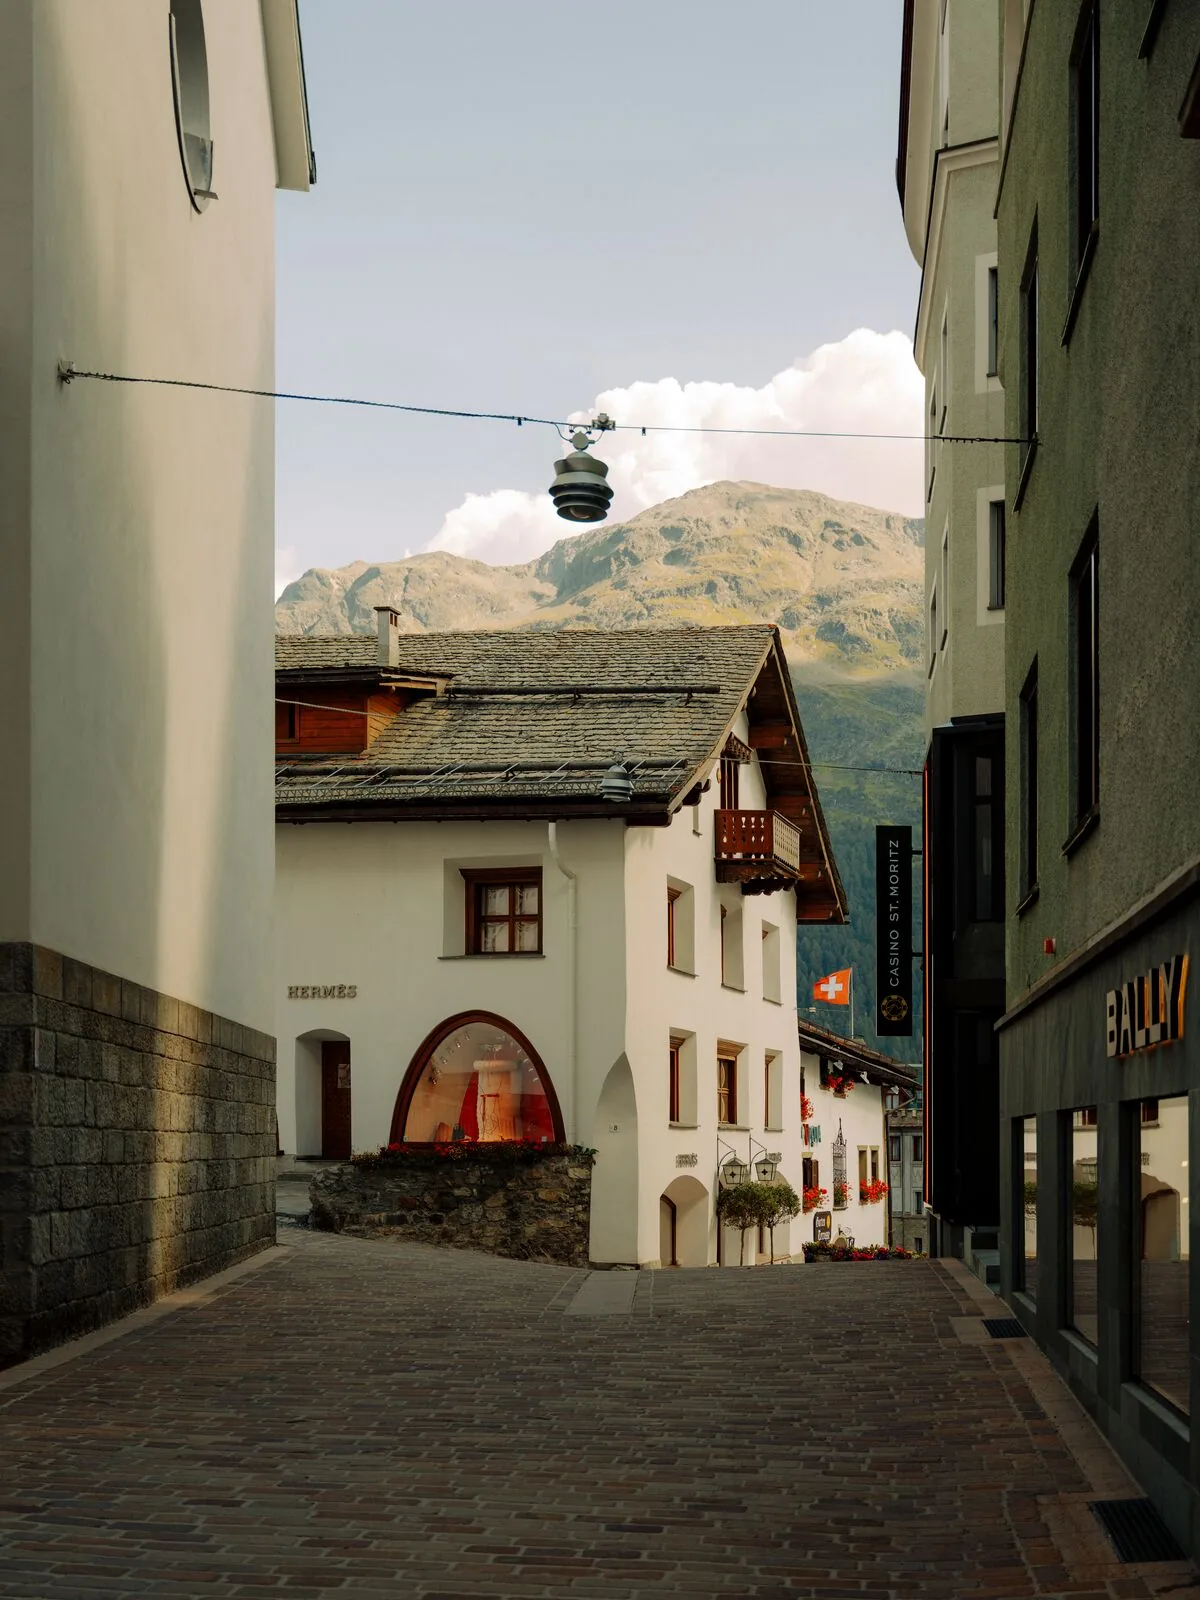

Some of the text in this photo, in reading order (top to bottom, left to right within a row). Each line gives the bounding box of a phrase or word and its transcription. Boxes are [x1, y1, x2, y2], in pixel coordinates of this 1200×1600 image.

[889, 839, 900, 987] CASINO ST. MORITZ
[1106, 954, 1187, 1058] BALLY
